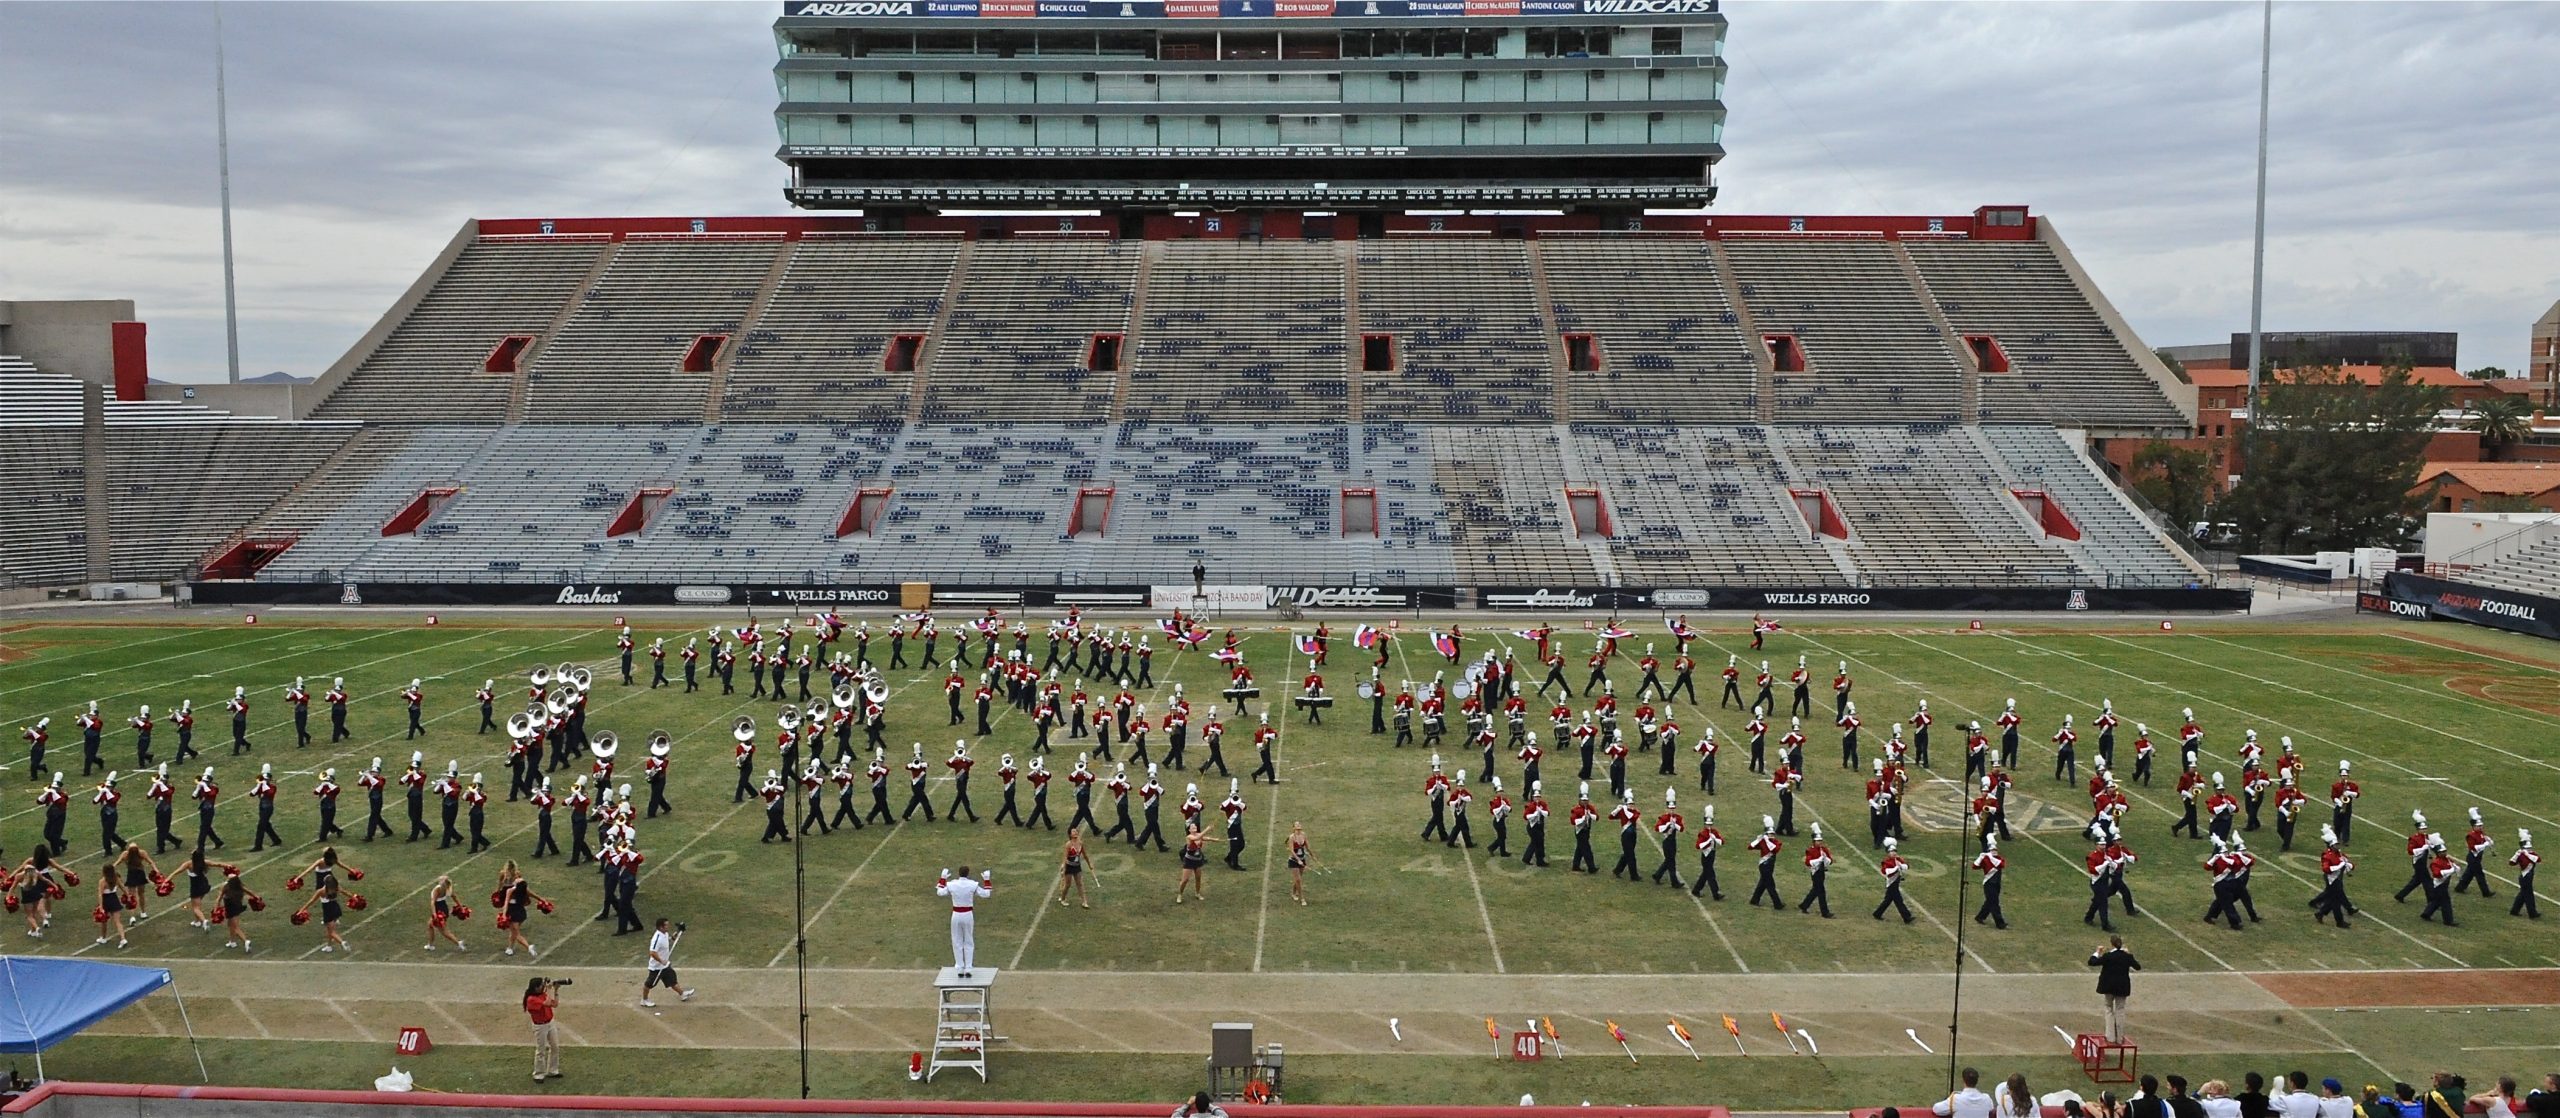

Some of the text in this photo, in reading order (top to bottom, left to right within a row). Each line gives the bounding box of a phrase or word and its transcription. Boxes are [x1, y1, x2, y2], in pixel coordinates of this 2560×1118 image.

[796, 3, 913, 16] ARIZONA
[928, 3, 936, 11] 22
[1039, 3, 1044, 11] 6
[1165, 4, 1170, 12] 4
[1521, 1, 1526, 9] 5
[1583, 0, 1711, 13] WILDCATS
[542, 225, 553, 234] 17
[693, 223, 704, 233] 18
[866, 223, 876, 232] 19
[1060, 223, 1072, 231] 20
[1208, 222, 1219, 231] 21
[1431, 222, 1442, 231] 22
[1628, 222, 1641, 231] 23
[1790, 223, 1803, 232] 24
[1929, 223, 1942, 232] 25
[184, 389, 194, 397] 16
[556, 585, 622, 604] Bashas'
[785, 590, 889, 601] WELLS FARGO
[1154, 592, 1188, 602] UNIVERSITY
[1230, 592, 1249, 602] BAND
[1250, 592, 1263, 602] DAY
[1764, 593, 1870, 604] WELLS FARGO
[2362, 596, 2426, 618] BEAR DOWN
[2437, 593, 2536, 620] ARIZONA FOOTBALL
[399, 1030, 418, 1051] 40
[1517, 1036, 1537, 1057] 40
